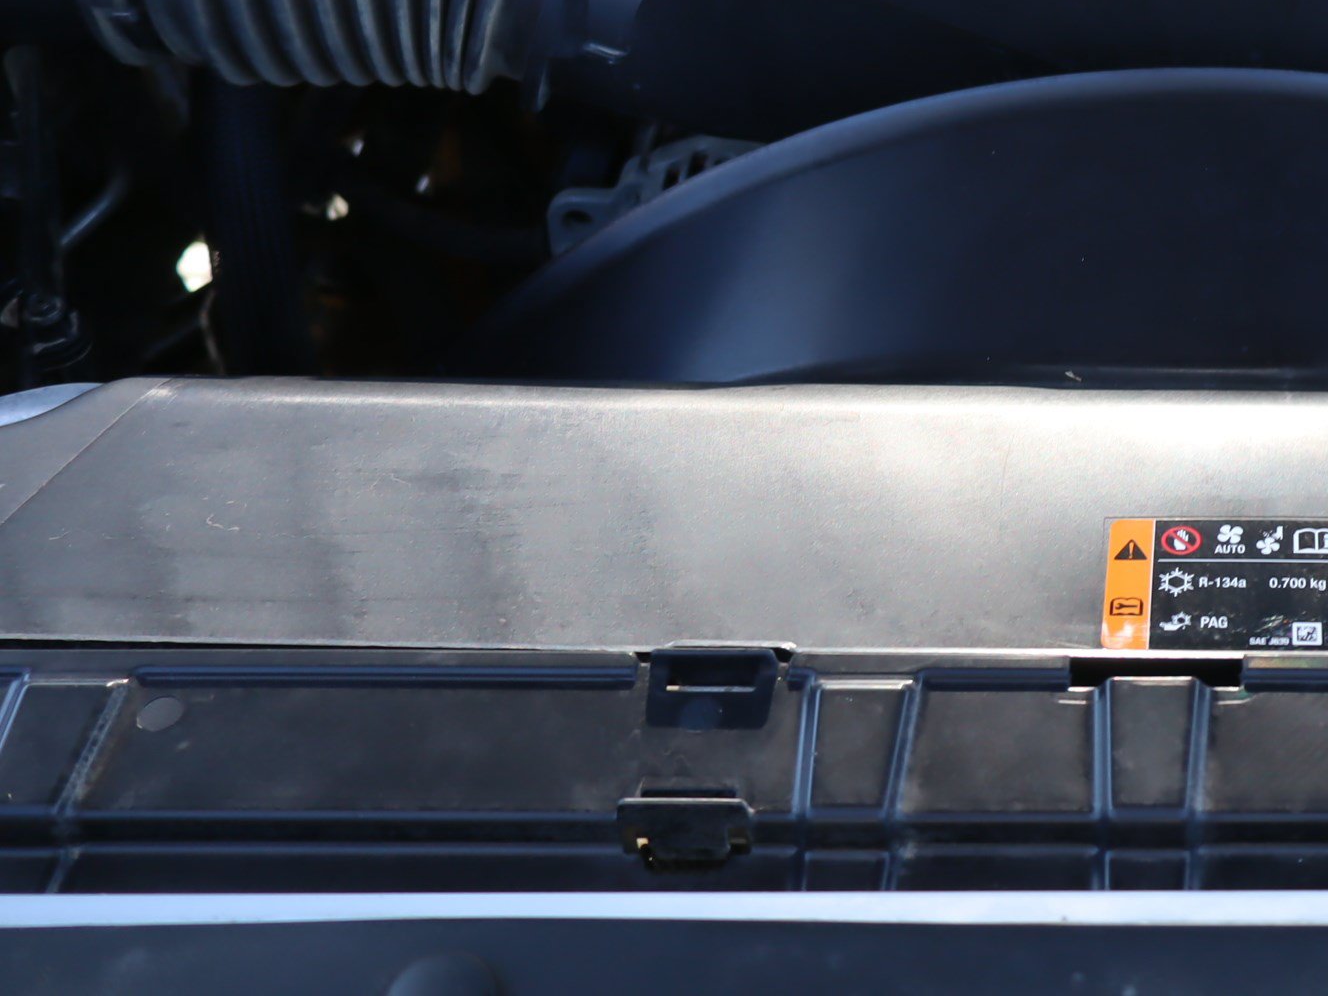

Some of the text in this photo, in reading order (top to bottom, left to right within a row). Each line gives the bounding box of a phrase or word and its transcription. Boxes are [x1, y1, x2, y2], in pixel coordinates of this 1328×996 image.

[1214, 544, 1246, 554] AUTO
[1198, 577, 1327, 591] R-134a 0.700 kg
[1200, 616, 1228, 629] PAG
